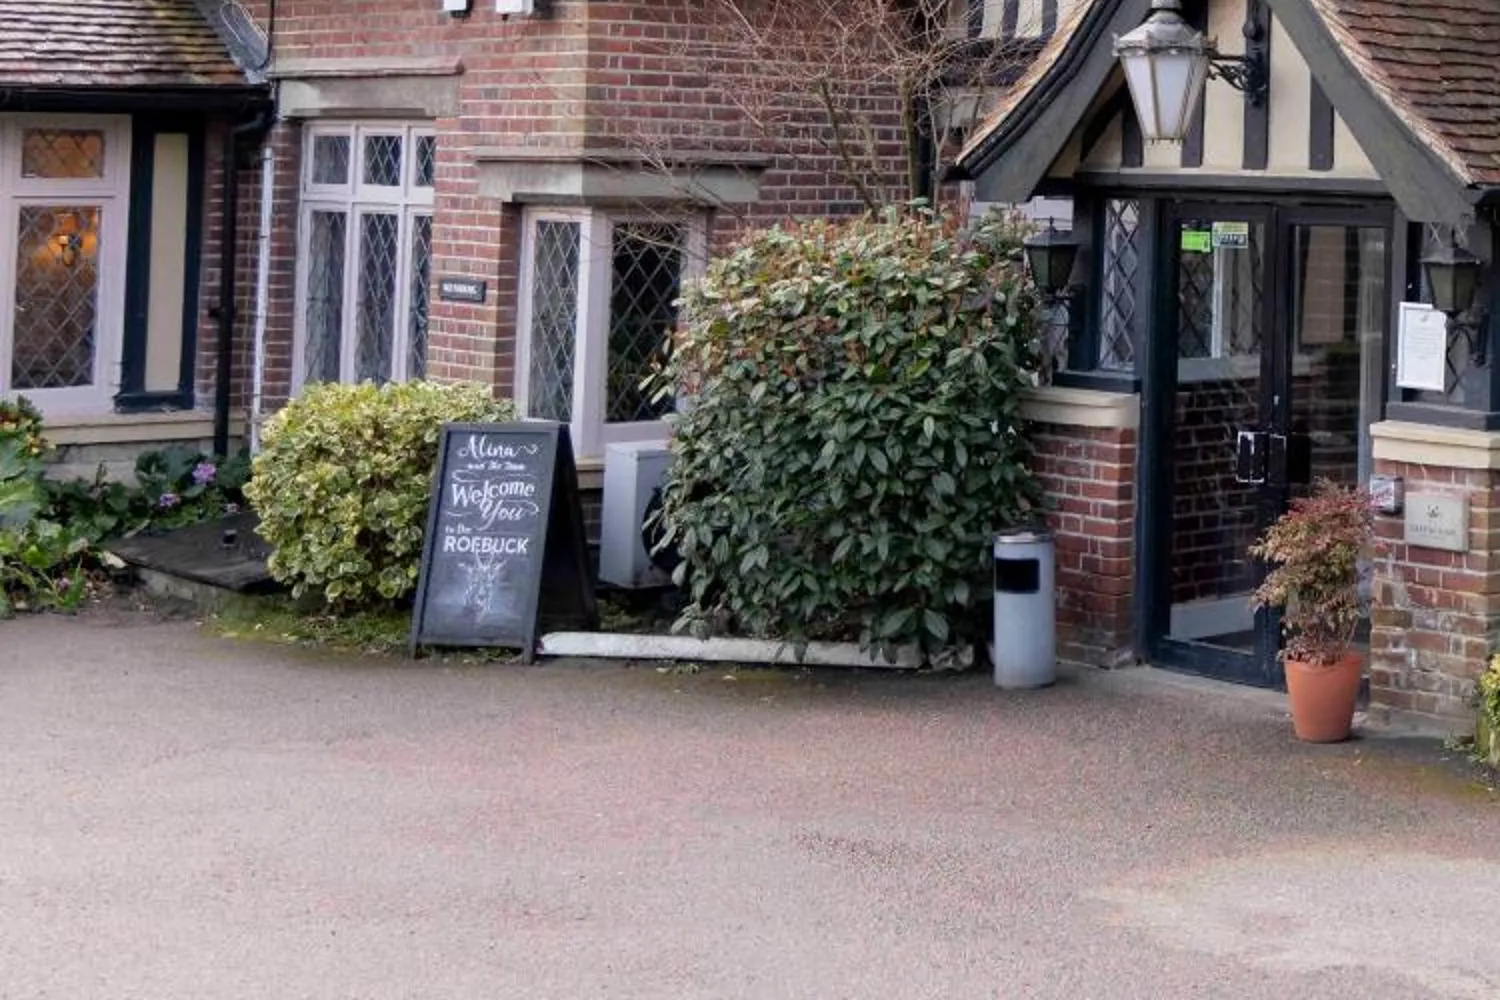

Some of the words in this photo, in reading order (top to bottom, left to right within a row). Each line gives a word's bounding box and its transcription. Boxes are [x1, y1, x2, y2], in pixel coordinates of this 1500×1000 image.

[451, 480, 535, 508] Welcome
[476, 499, 523, 532] You
[443, 535, 529, 554] ROEBUCK
